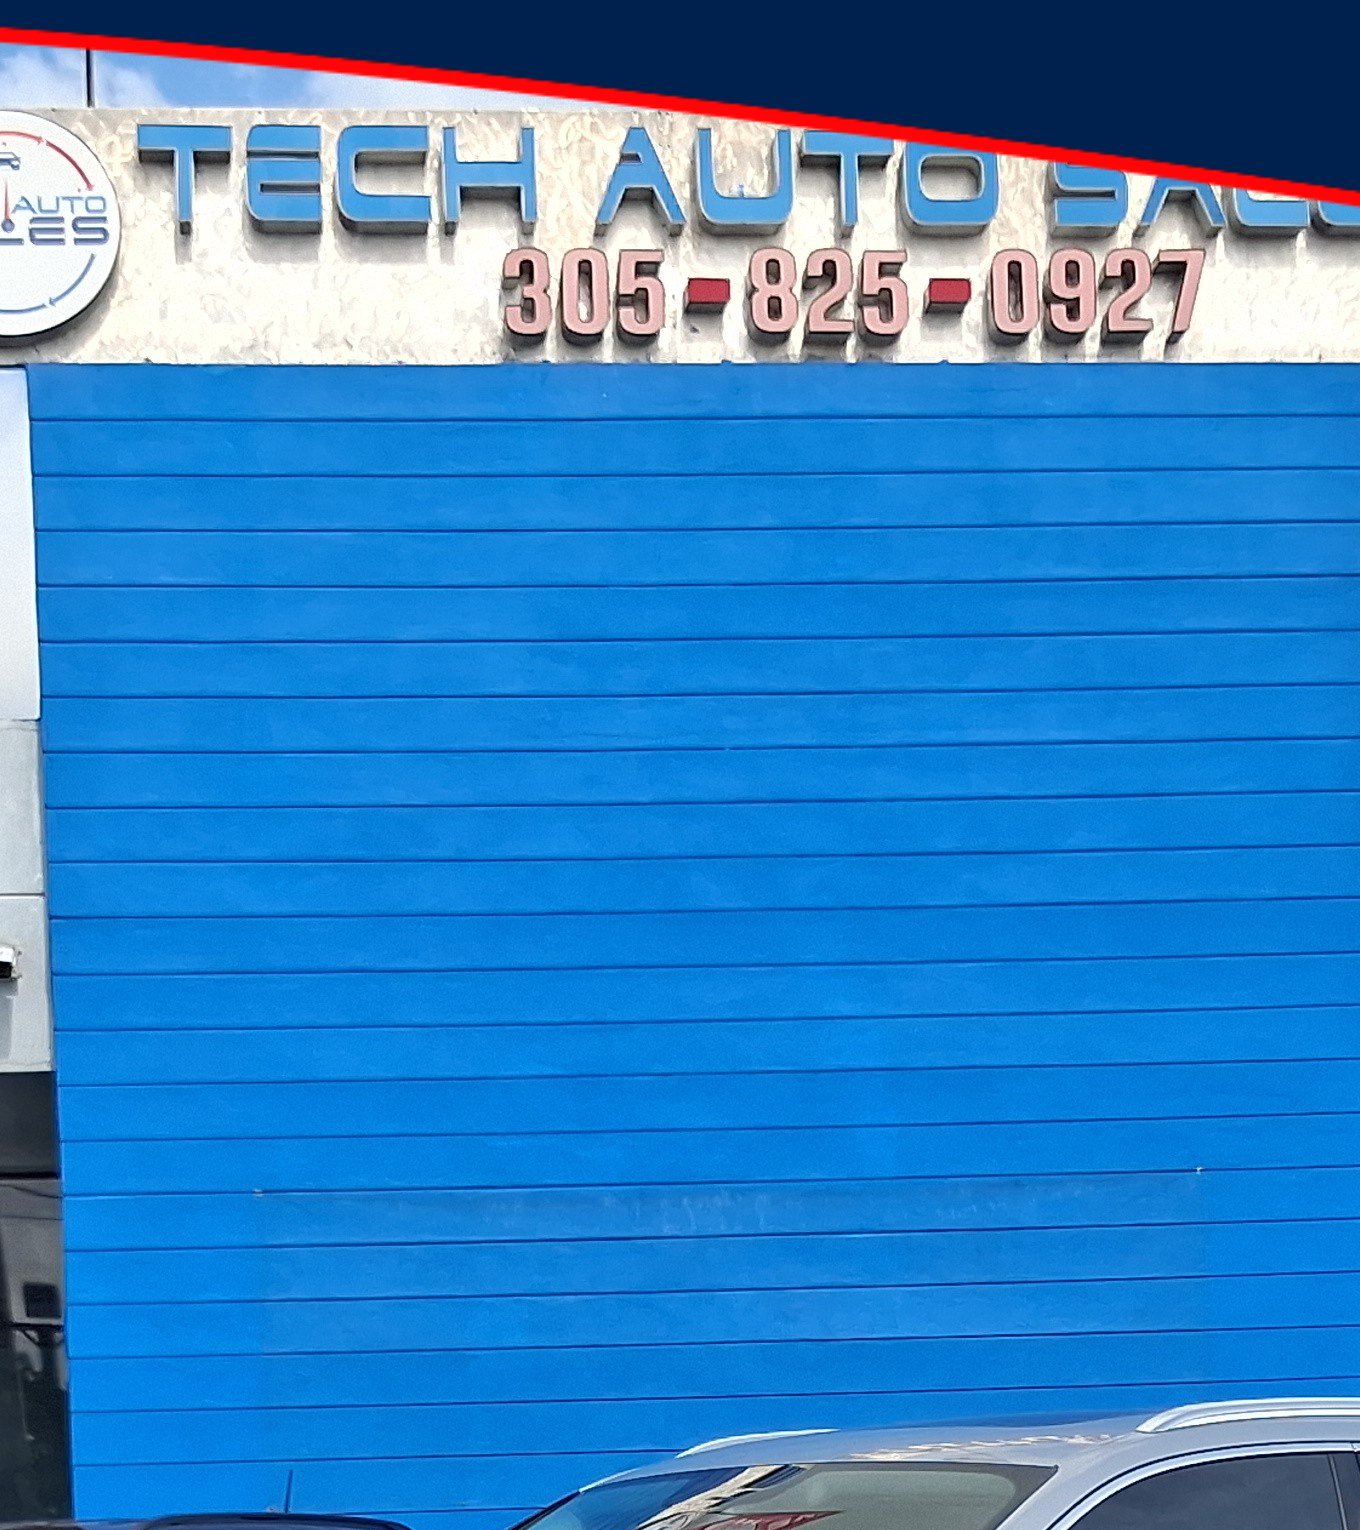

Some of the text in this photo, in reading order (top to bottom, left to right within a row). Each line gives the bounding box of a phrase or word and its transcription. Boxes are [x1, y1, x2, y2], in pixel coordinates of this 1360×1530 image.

[11, 195, 108, 215] AUTO
[138, 124, 537, 235] TECH
[596, 125, 999, 237] AUTO
[503, 247, 1206, 336] 305-825-0927
